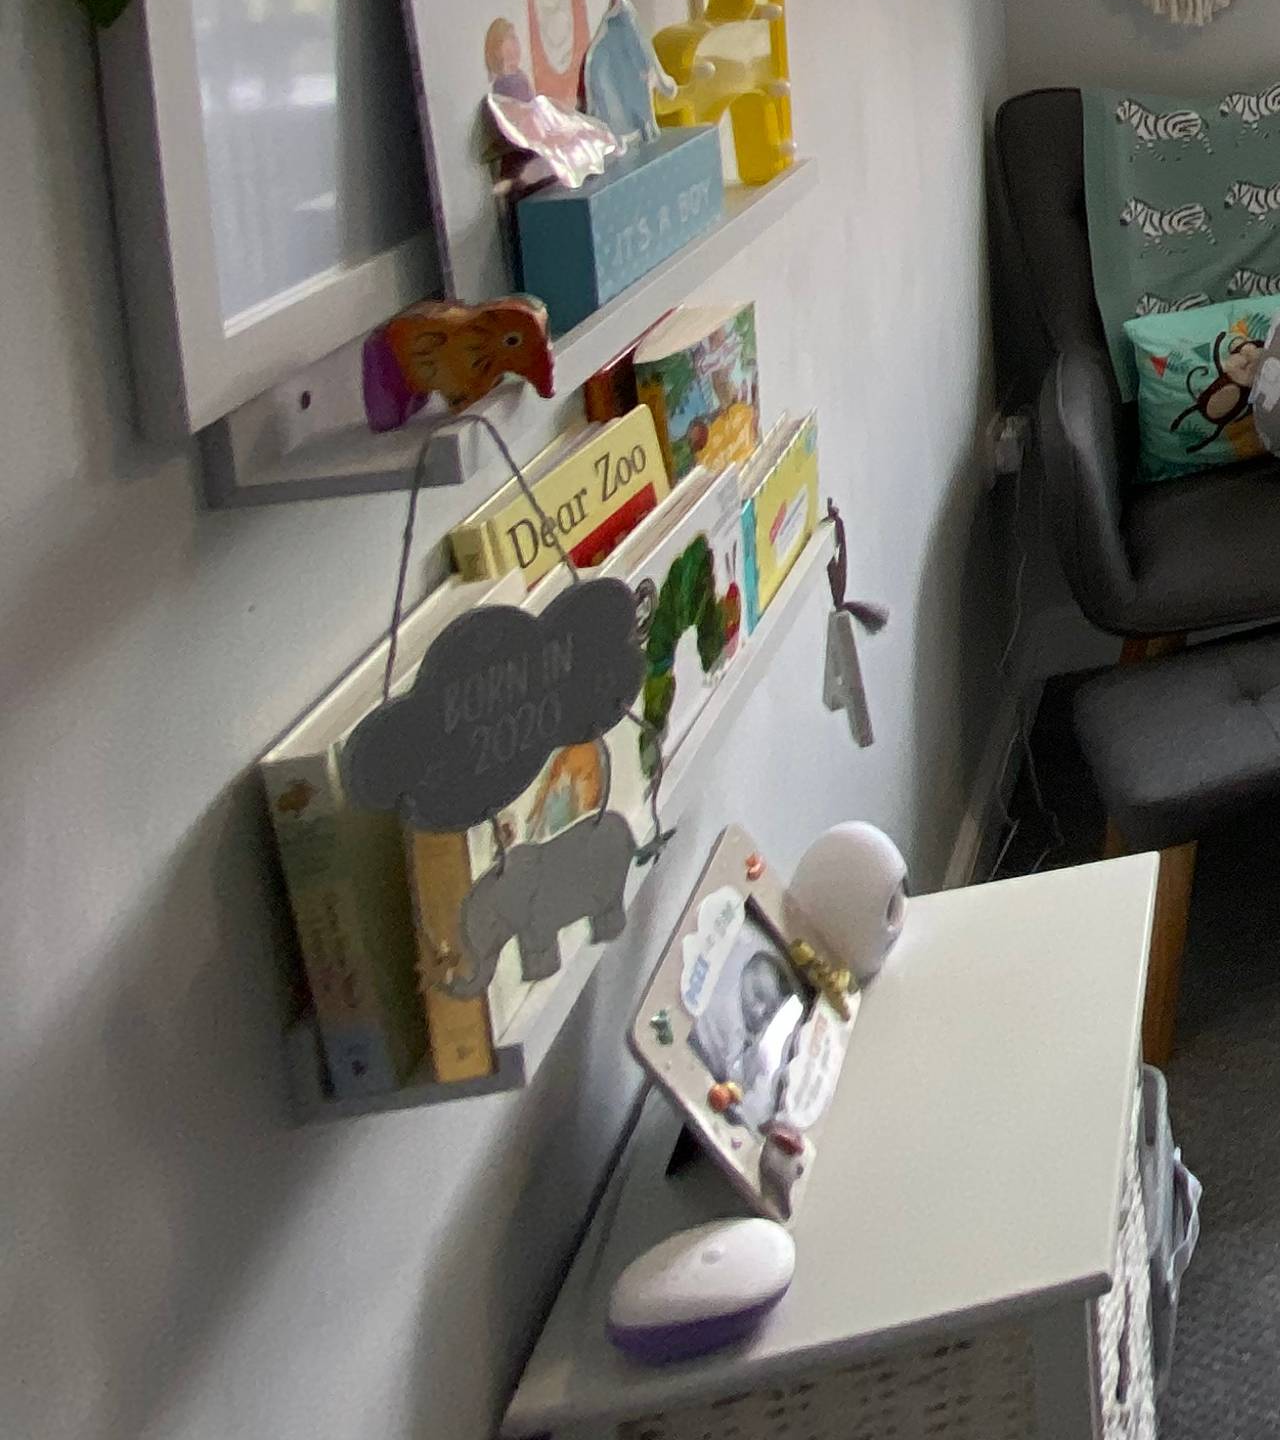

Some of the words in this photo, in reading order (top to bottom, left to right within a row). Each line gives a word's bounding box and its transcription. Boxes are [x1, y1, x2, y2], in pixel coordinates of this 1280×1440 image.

[657, 205, 672, 235] A
[506, 487, 588, 569] Dear
[594, 444, 647, 502] Zoo
[443, 651, 528, 734] BORN
[541, 632, 573, 688] IN
[470, 691, 562, 775] 2020
